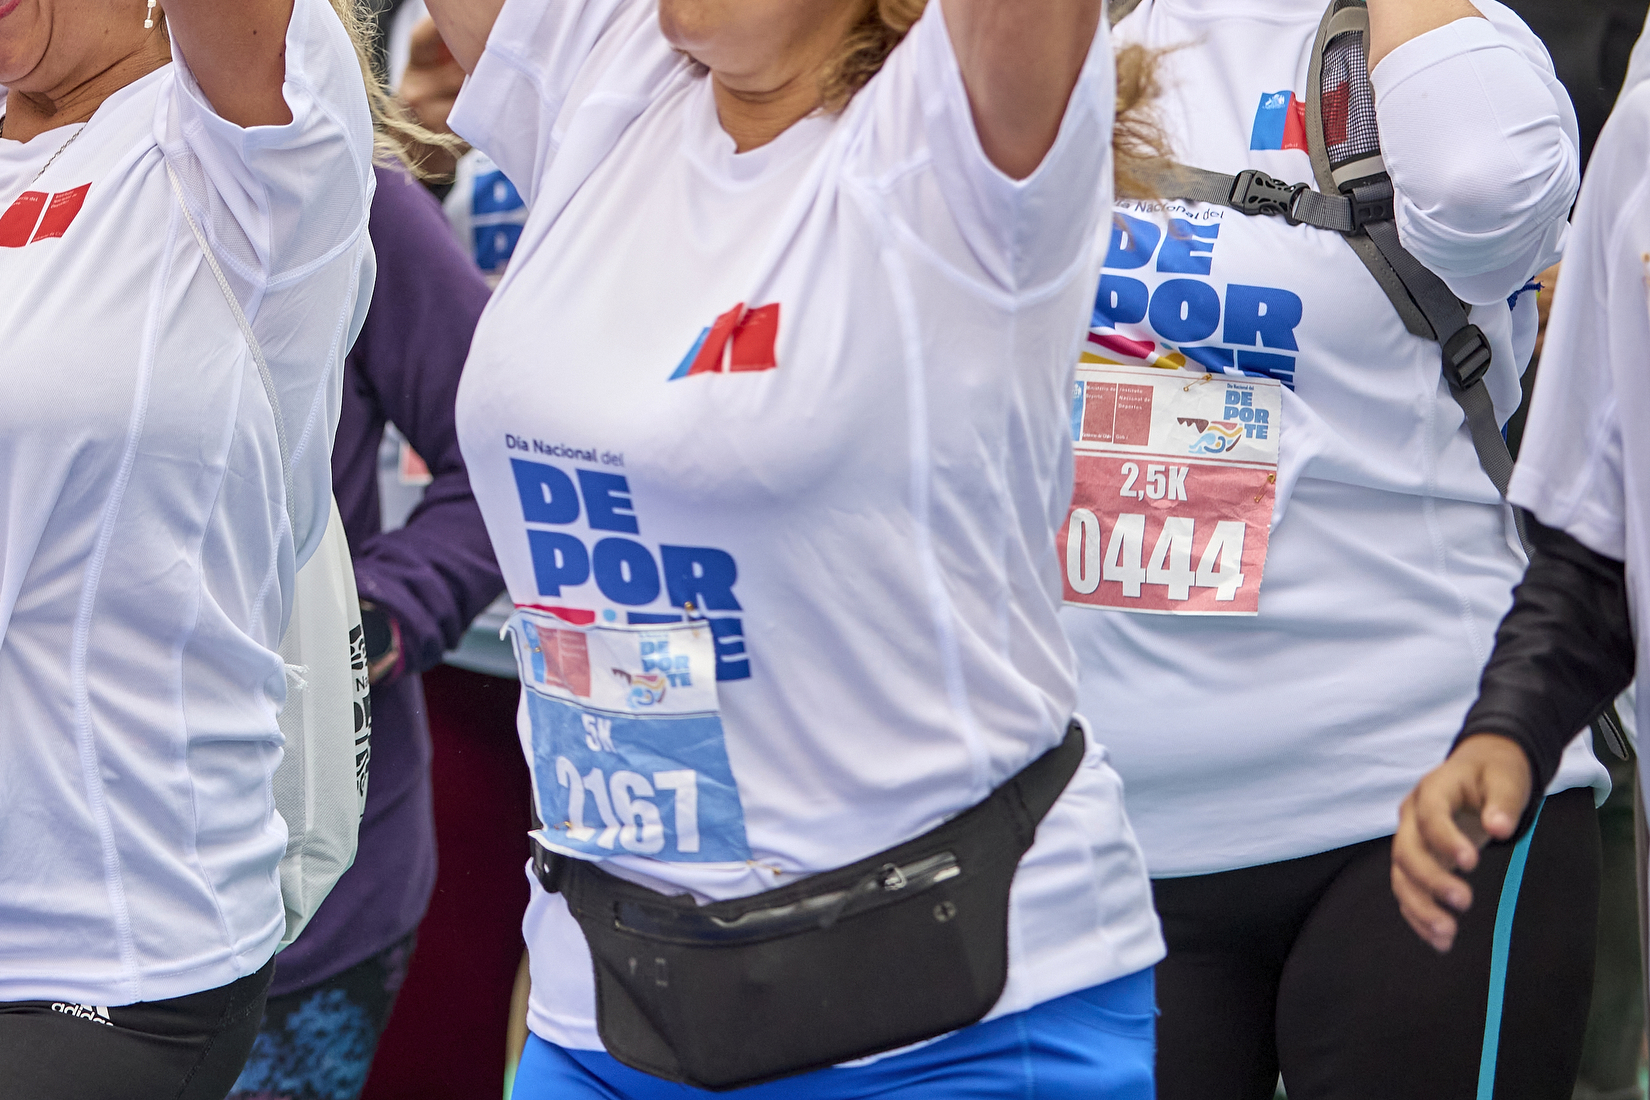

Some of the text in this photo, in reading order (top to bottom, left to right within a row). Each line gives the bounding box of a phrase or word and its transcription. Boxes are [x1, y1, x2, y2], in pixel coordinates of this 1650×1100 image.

[1100, 211, 1221, 276] DE
[1090, 273, 1303, 352] POR
[1223, 405, 1270, 424] POR
[1224, 390, 1253, 407] DE
[505, 433, 625, 467] Día Nacional del
[1244, 423, 1269, 440] TE
[509, 457, 641, 536] DE
[1119, 462, 1191, 502] 2,5K
[526, 528, 744, 612] POR
[1066, 507, 1247, 602] 0444
[580, 713, 617, 754] 5K
[555, 755, 700, 855] 2167
